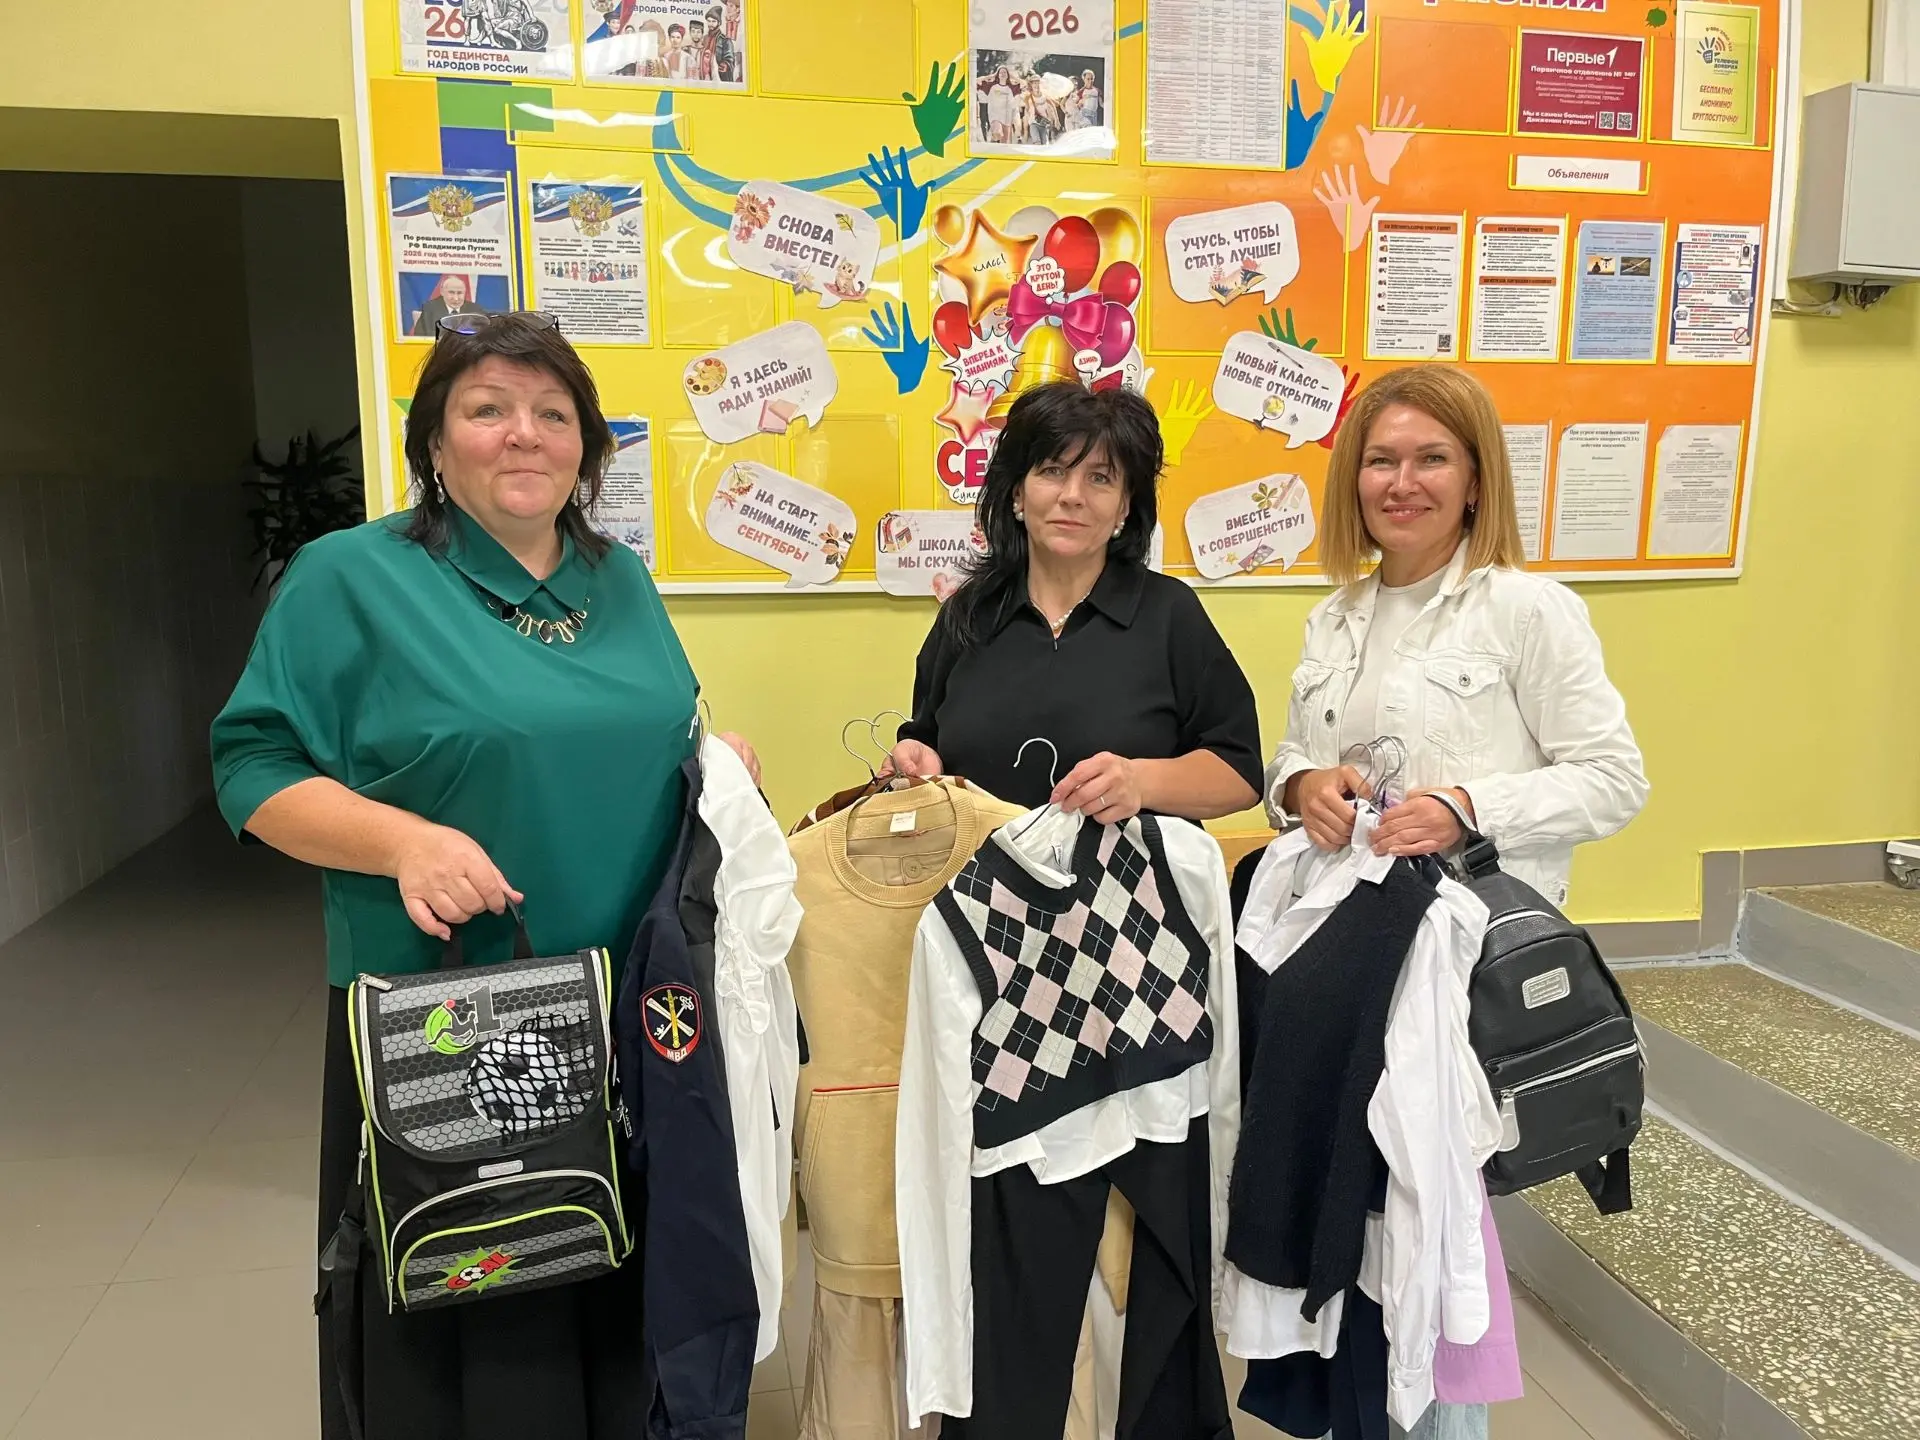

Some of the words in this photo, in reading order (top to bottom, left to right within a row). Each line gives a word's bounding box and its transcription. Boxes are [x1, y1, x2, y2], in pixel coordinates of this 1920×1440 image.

[670, 6, 704, 15] России
[424, 6, 465, 39] 26
[1008, 5, 1079, 41] 2026
[427, 50, 449, 59] ГОД
[452, 52, 510, 62] ЕДИНСТВА
[427, 60, 480, 71] НАРОДОВ
[483, 64, 528, 74] РОССИИ
[1547, 48, 1605, 66] Первые
[1531, 66, 1572, 75] Первичное
[1699, 85, 1733, 95] БЕСПЛАТНО!
[1700, 99, 1733, 109] АНОНИМНО!
[1692, 112, 1739, 123] КРУГЛОСУТОЧНО!
[1547, 168, 1609, 181] Объявления
[778, 215, 834, 245] СНОВА
[1181, 228, 1231, 251] УЧУСЬ,
[1234, 224, 1280, 242] ЧТОБЫ
[422, 243, 466, 251] Владимира
[468, 244, 495, 252] Путина
[764, 234, 839, 269] ВМЕСТЕ!
[1184, 251, 1225, 271] СТАТЬ
[1229, 242, 1282, 265] ЛУЧШЕ!
[1036, 263, 1052, 272] ЭТО
[1036, 281, 1059, 292] ДЕНЬ!
[962, 348, 996, 367] ВПЕРЕД
[996, 345, 1004, 354] К
[965, 354, 1009, 378] ЗНАНИЯМ!
[729, 376, 741, 390] Я
[746, 358, 789, 384] ЗДЕСЬ
[1234, 350, 1278, 375] НОВЫЙ
[1279, 366, 1320, 390] КЛАСС
[718, 392, 755, 414] РАДИ
[758, 366, 813, 399] ЗНАНИЙ!
[1222, 364, 1265, 389] НОВЫЕ
[1266, 379, 1333, 414] ОТКРЫТИЯ!
[754, 488, 775, 506] НА
[778, 499, 819, 527] СТАРТ,
[739, 504, 819, 547] ВНИМАНИЕ...
[1225, 507, 1271, 531] ВМЕСТЕ
[919, 539, 970, 552] ШКОЛА,
[1198, 542, 1207, 556] К
[1208, 514, 1305, 553] СОВЕРШЕНСТВУ!
[898, 556, 920, 568] МЫ
[666, 1046, 688, 1061] МВД
